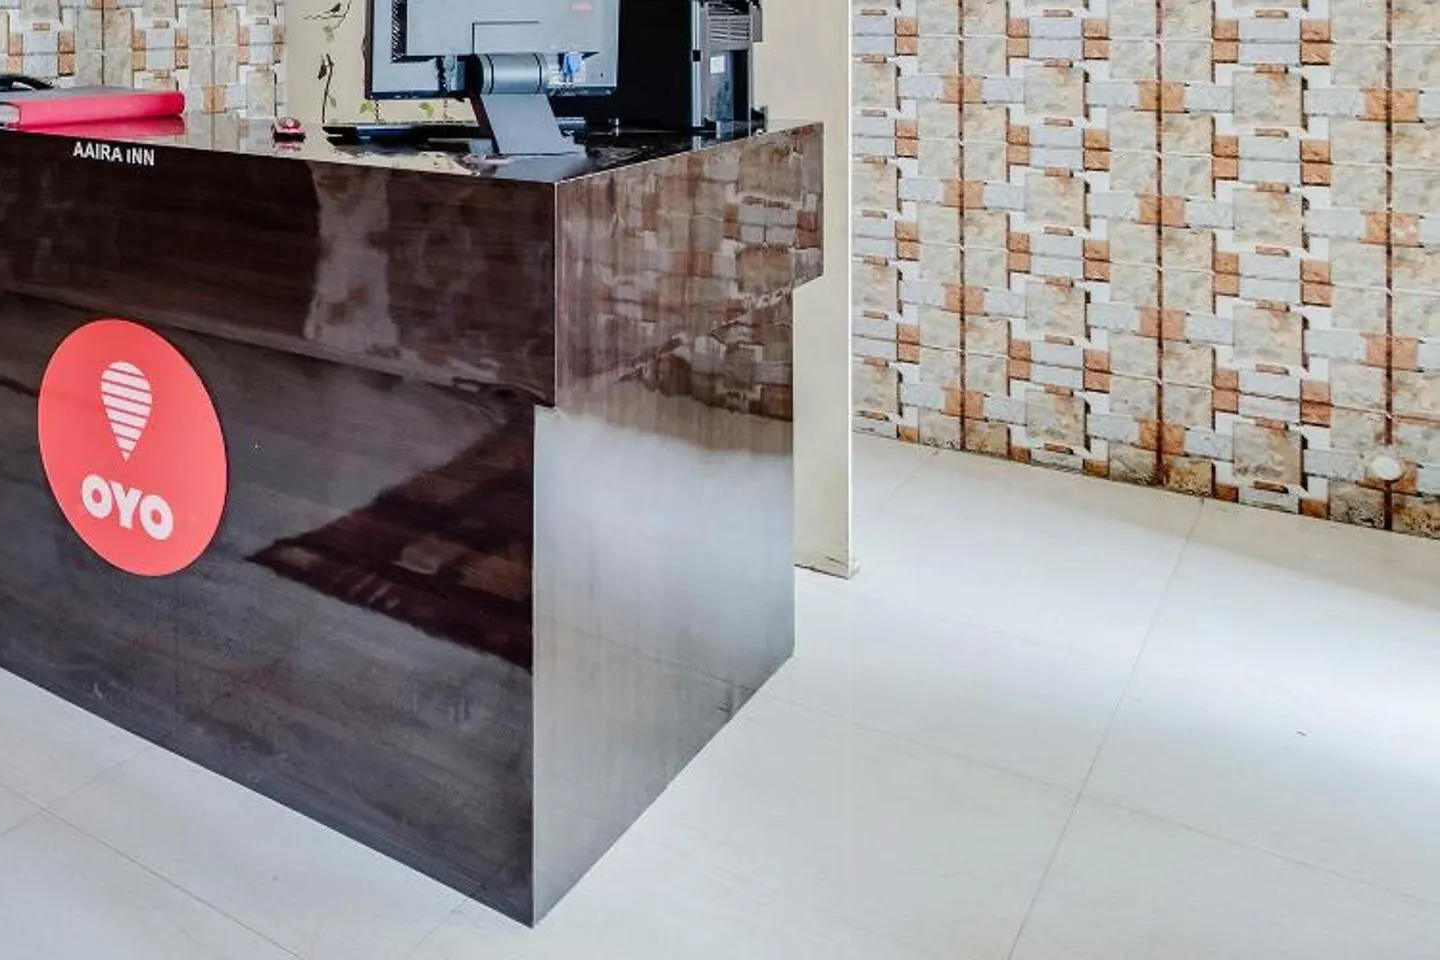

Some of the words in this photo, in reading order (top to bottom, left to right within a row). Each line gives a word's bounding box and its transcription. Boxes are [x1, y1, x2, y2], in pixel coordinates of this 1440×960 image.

[72, 141, 124, 162] AAIRA
[126, 147, 155, 166] INN
[81, 473, 174, 541] OYO
